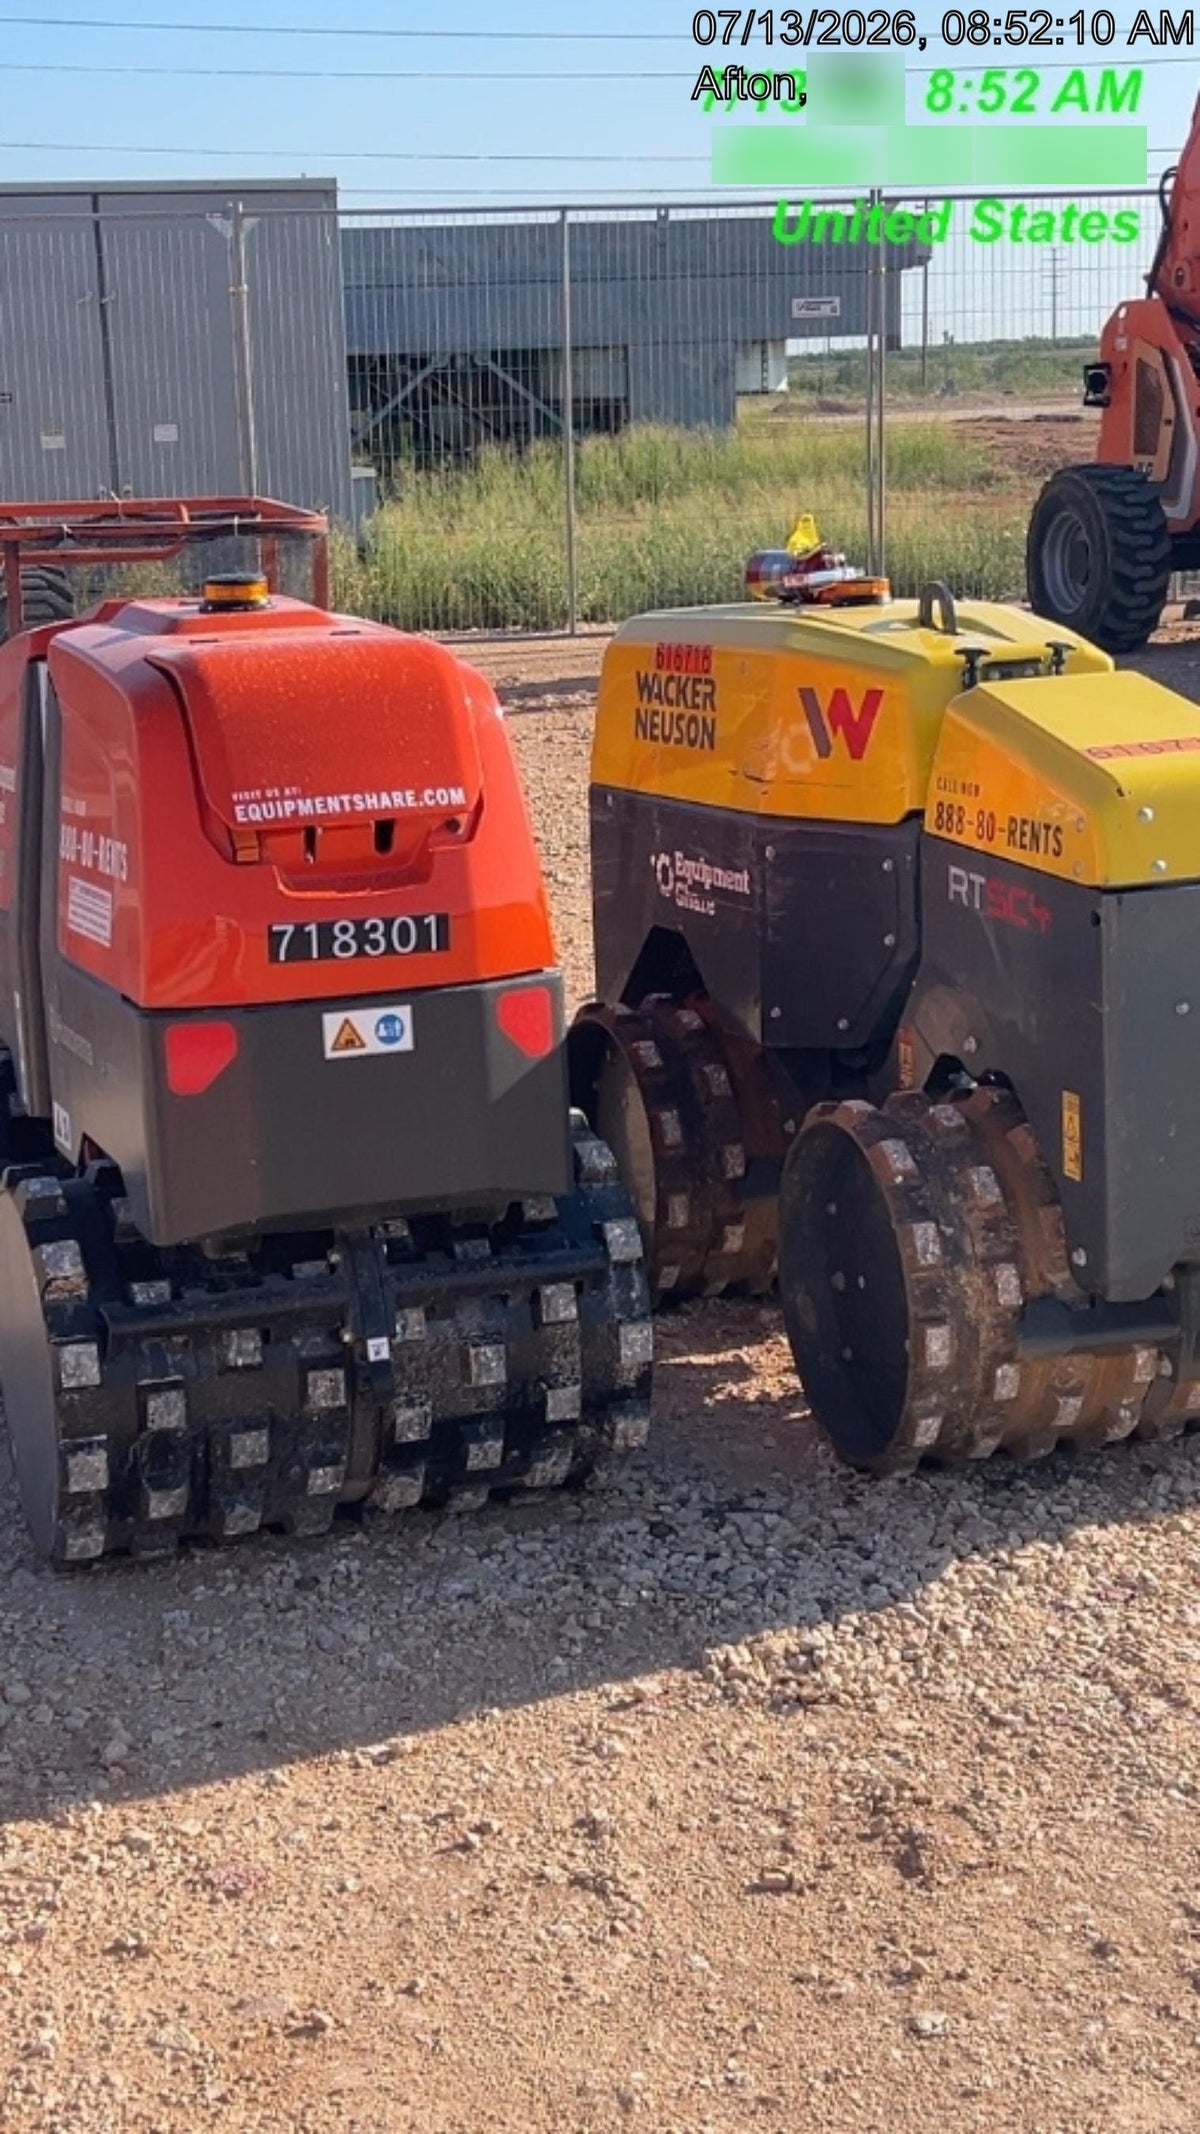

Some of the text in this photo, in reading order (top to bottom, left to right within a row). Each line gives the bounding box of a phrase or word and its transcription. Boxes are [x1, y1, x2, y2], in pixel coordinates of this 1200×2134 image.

[635, 671, 717, 712] WACKER
[635, 707, 716, 750] NEUSON
[234, 787, 467, 823] EQUIPMENTSHARE.COM
[935, 801, 1064, 857] 888-80-RENTS
[674, 850, 750, 895] Equipment
[271, 914, 441, 962] 718301
